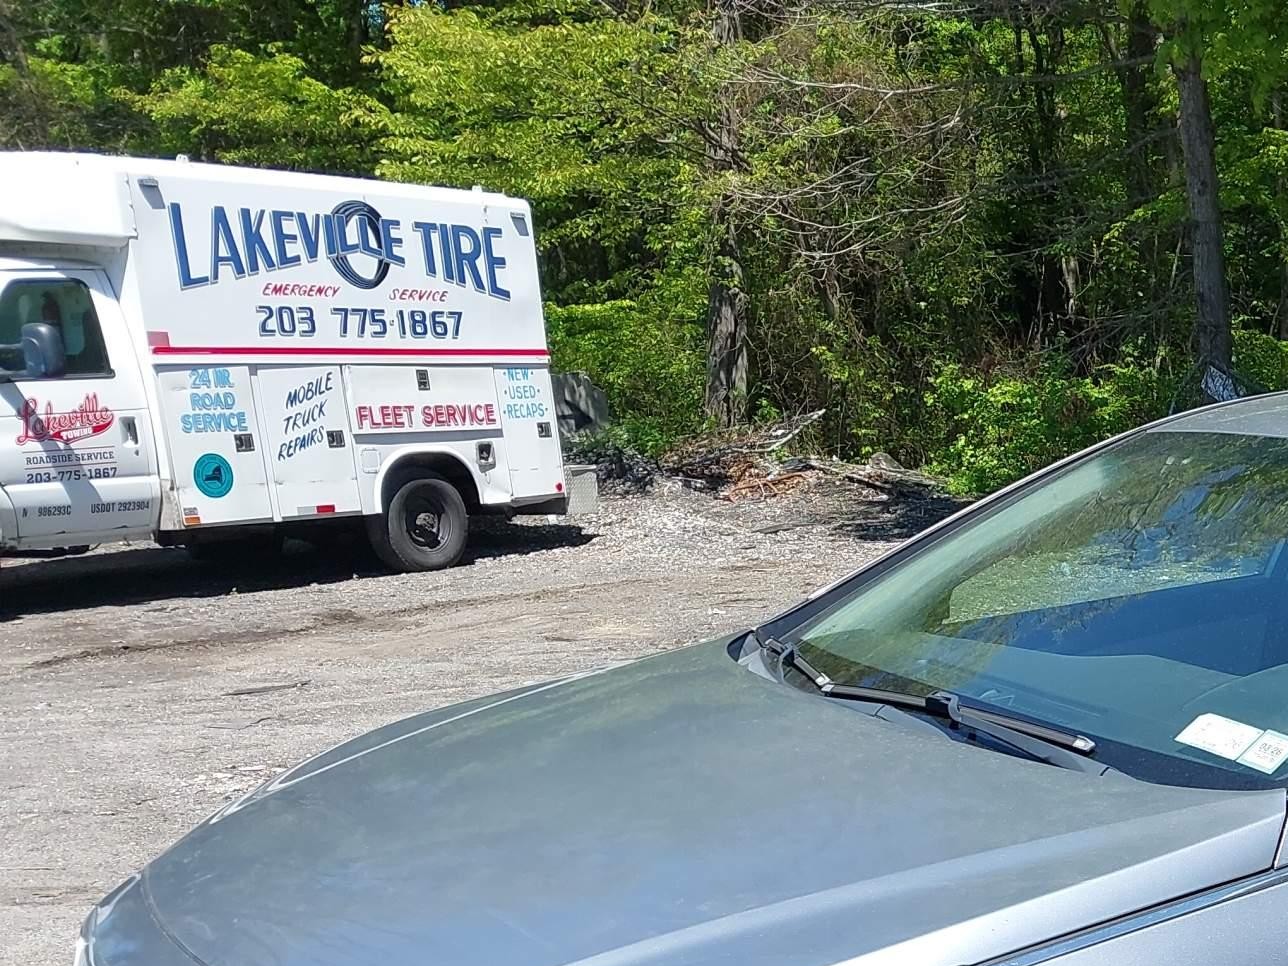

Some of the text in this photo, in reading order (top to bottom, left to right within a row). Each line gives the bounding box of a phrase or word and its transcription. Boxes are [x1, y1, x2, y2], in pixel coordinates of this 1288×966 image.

[168, 202, 511, 302] LAKEVILLE TIRE
[262, 282, 449, 303] EMERGENCY SERVICE
[256, 305, 316, 337] 203
[190, 367, 211, 389] 24
[507, 367, 529, 382] NEW
[285, 371, 333, 410] MOBILE
[508, 385, 536, 400] USED
[190, 392, 236, 411] ROAD
[506, 402, 545, 419] RECAPS
[16, 392, 114, 446] Lakeville
[180, 411, 248, 434] SERVICE
[283, 399, 328, 435] TRUCK
[355, 403, 497, 430] FLEET SERVICE
[60, 427, 93, 440] TOWING
[277, 425, 325, 462] REPAIRS
[25, 451, 114, 466] ROADSIDE SERVICE
[26, 467, 117, 484] 203-775-1867
[90, 502, 116, 514] USDOT
